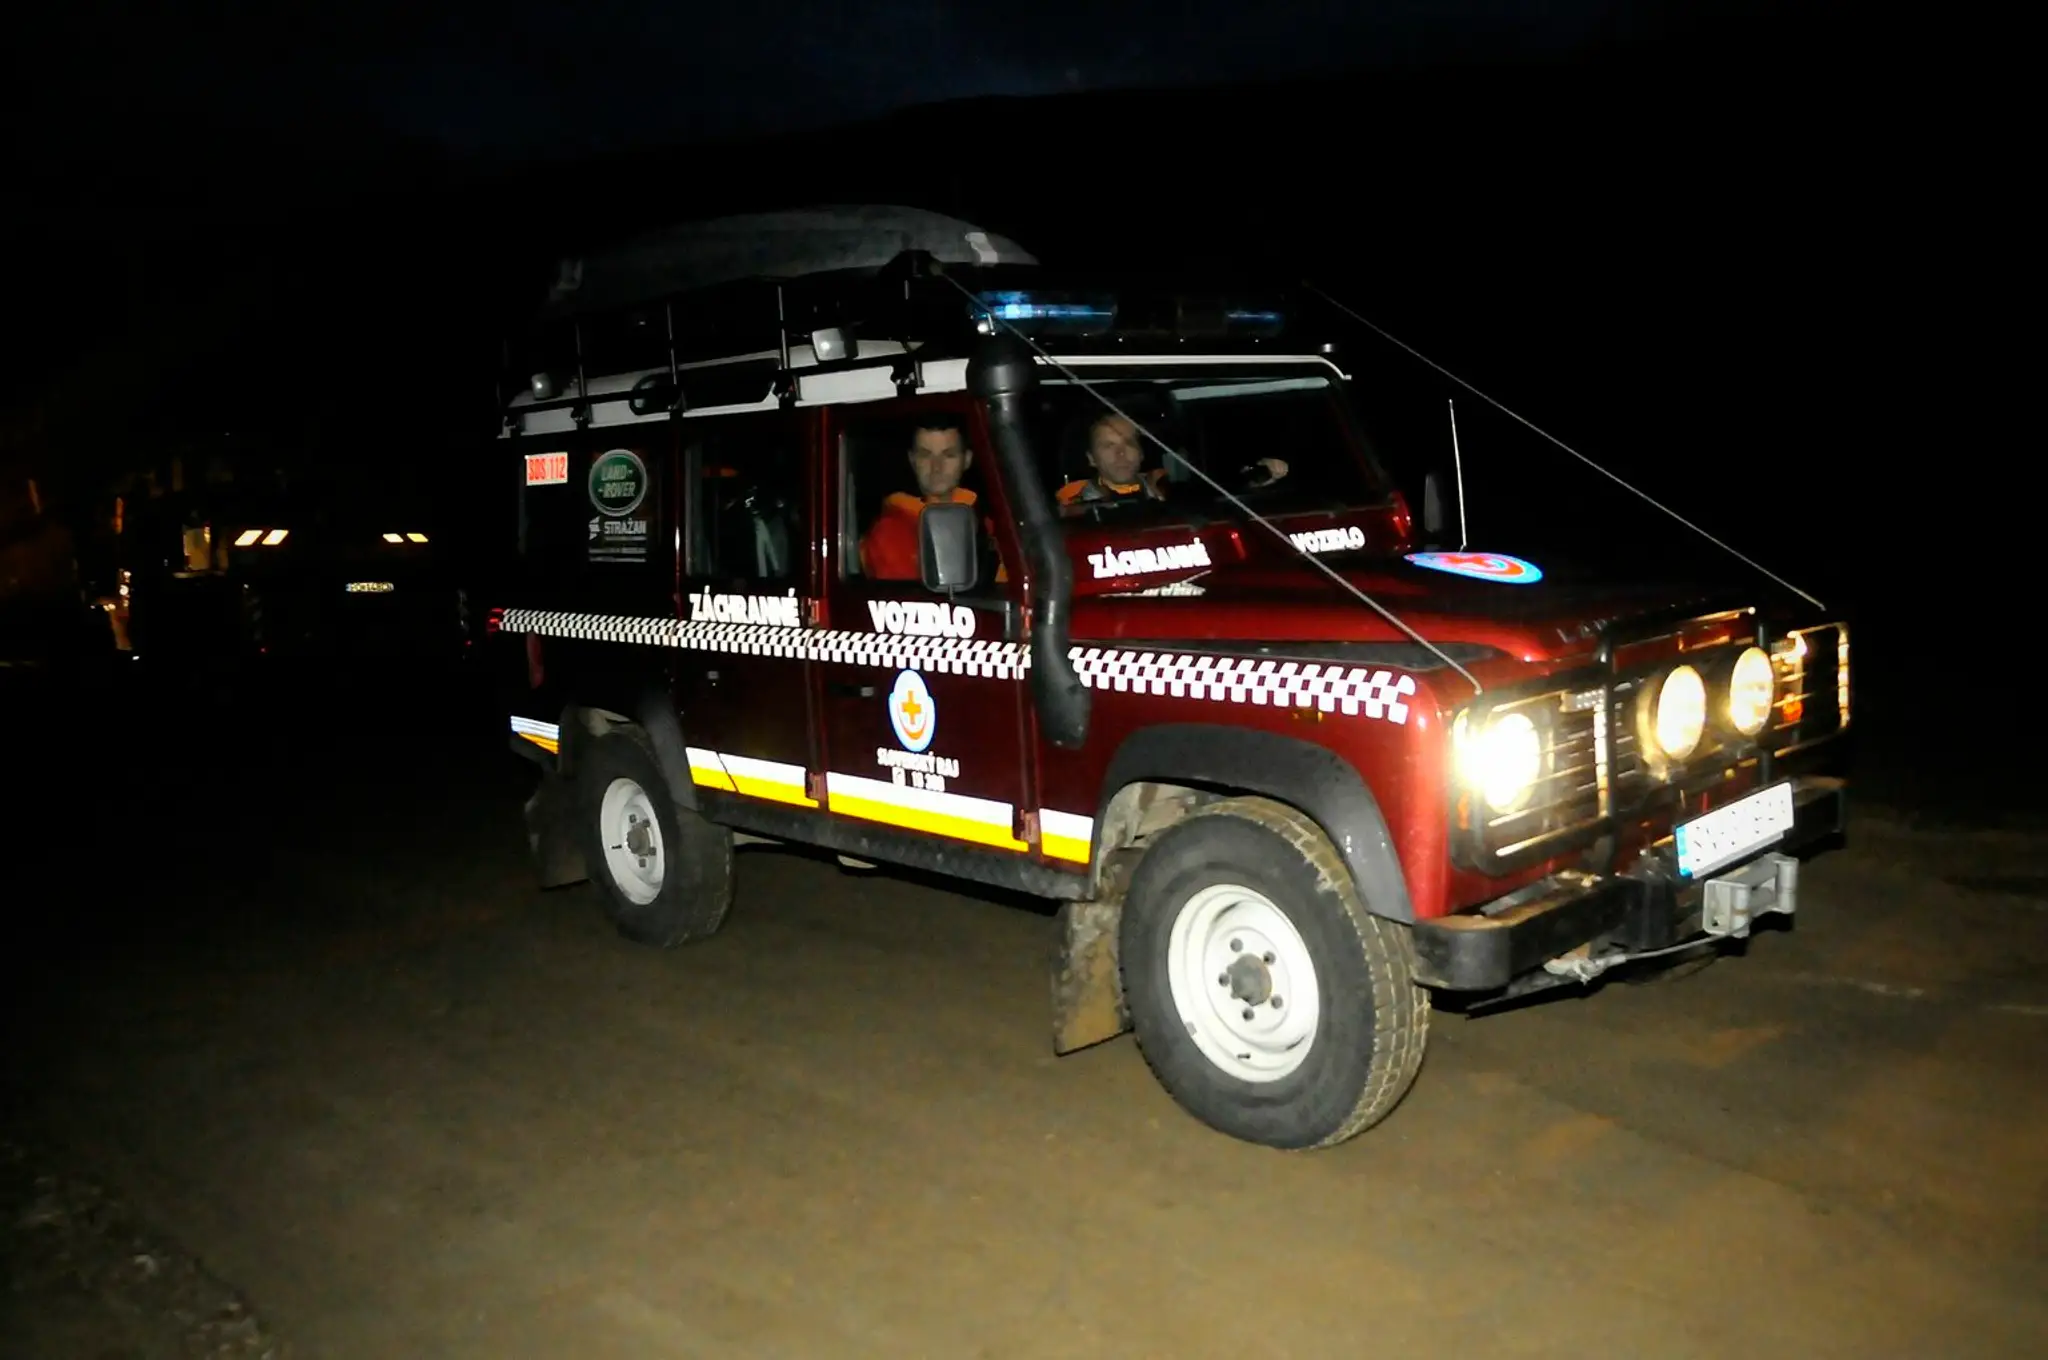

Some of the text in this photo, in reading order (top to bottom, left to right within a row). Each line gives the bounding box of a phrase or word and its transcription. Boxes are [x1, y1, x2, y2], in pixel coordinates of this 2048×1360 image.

[528, 455, 567, 481] SOS 112
[688, 585, 976, 639] ZÁCHRANNÉ VOZIDLO
